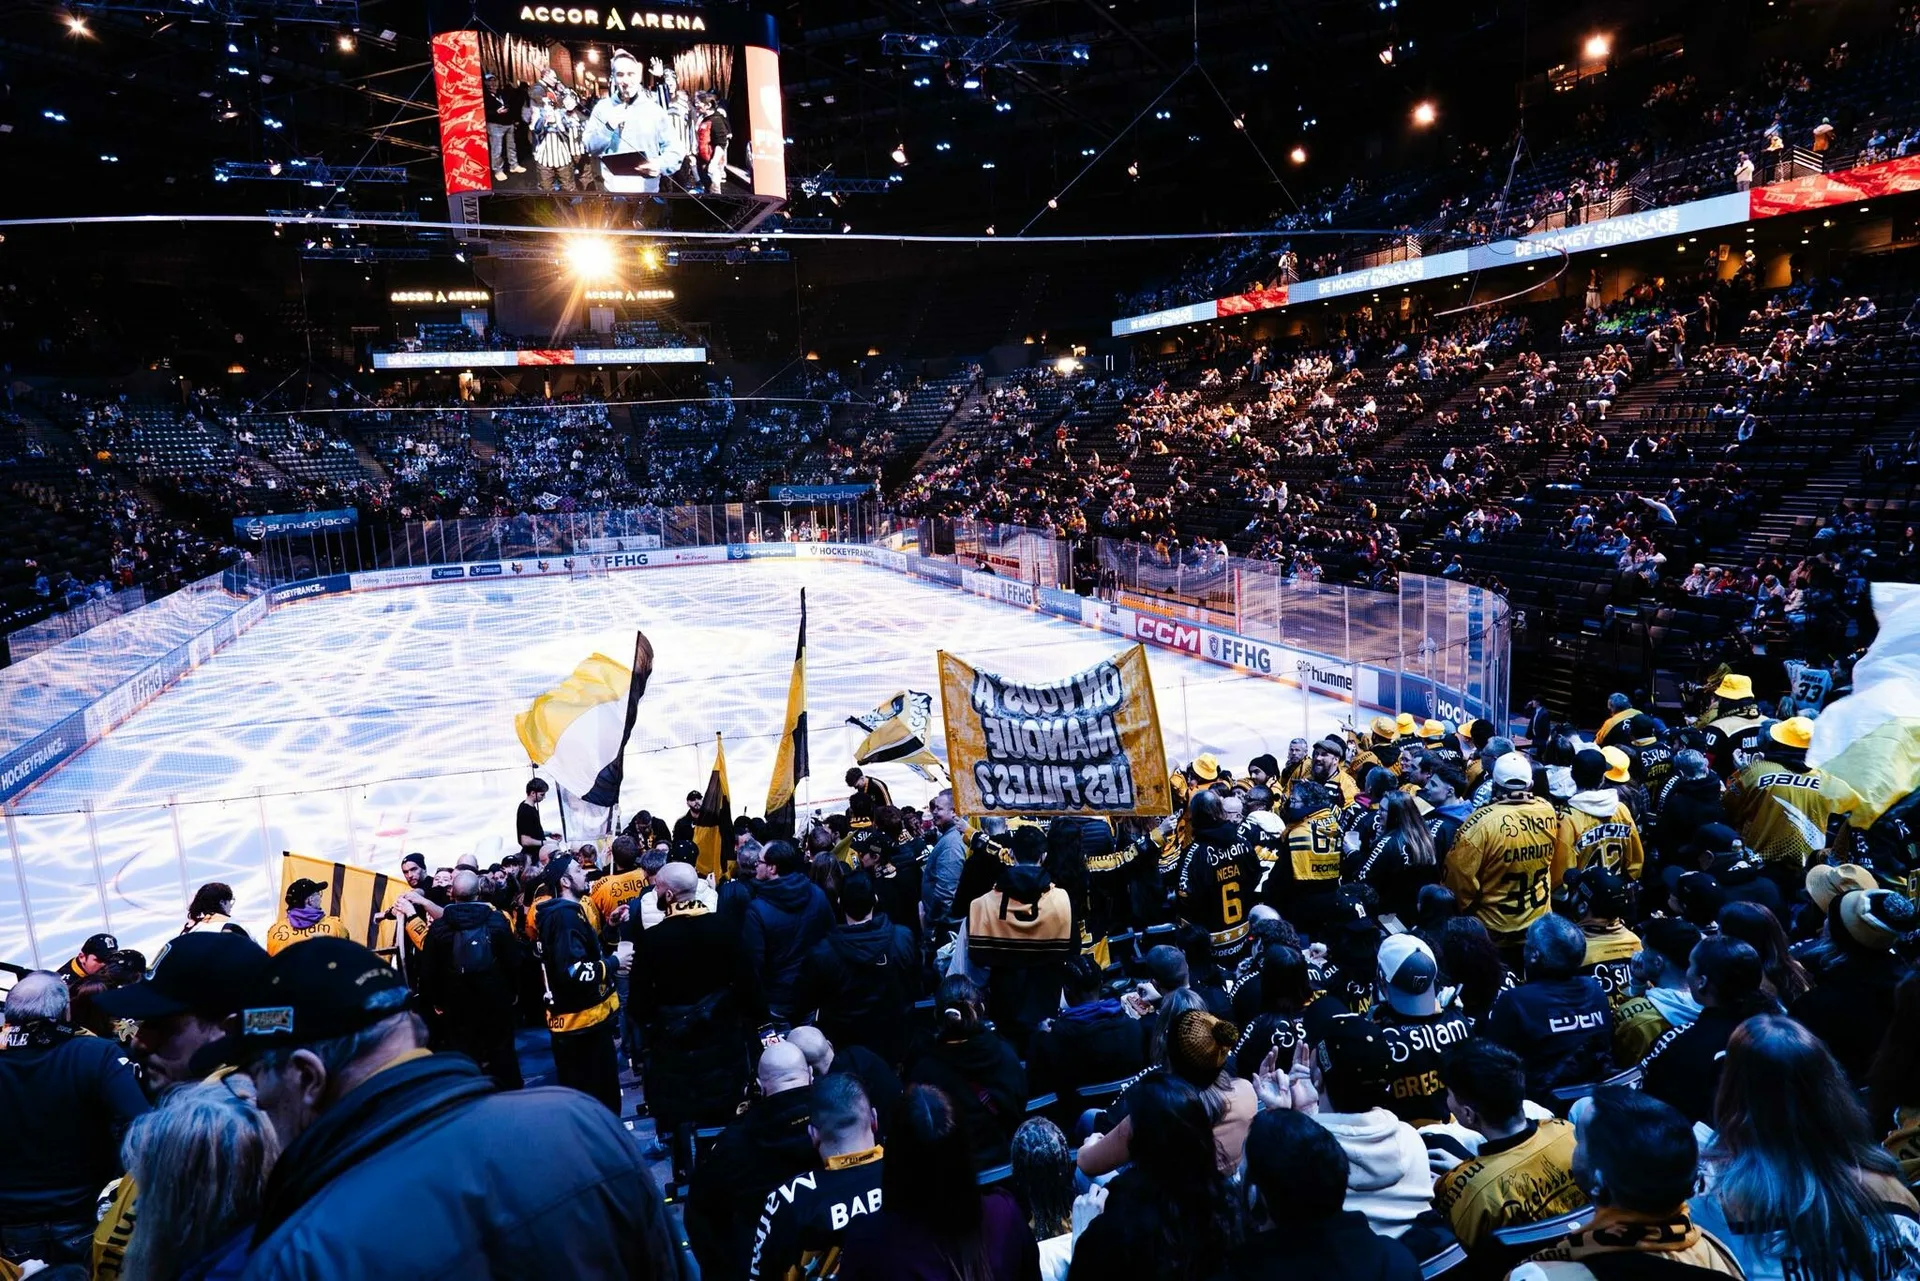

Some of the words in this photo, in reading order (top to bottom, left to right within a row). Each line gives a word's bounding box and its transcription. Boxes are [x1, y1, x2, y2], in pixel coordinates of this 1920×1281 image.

[520, 6, 599, 25] ACCOR
[631, 12, 706, 31] ARENA
[1515, 242, 1532, 257] DE
[1536, 231, 1591, 252] HOCKEY
[391, 292, 433, 302] ACCOR
[448, 291, 490, 301] ARENA
[585, 290, 624, 300] ACCOR
[636, 290, 675, 300] ARENA
[267, 517, 351, 532] synerglace
[604, 553, 649, 567] FFHG
[1007, 583, 1033, 604] FFHG
[1136, 615, 1199, 652] CCM
[1223, 638, 1272, 674] FFHG
[1312, 667, 1353, 691] humme
[1798, 682, 1824, 704] 33
[1216, 863, 1241, 882] NESA
[1221, 880, 1243, 925] 6
[1409, 1019, 1469, 1054] silam
